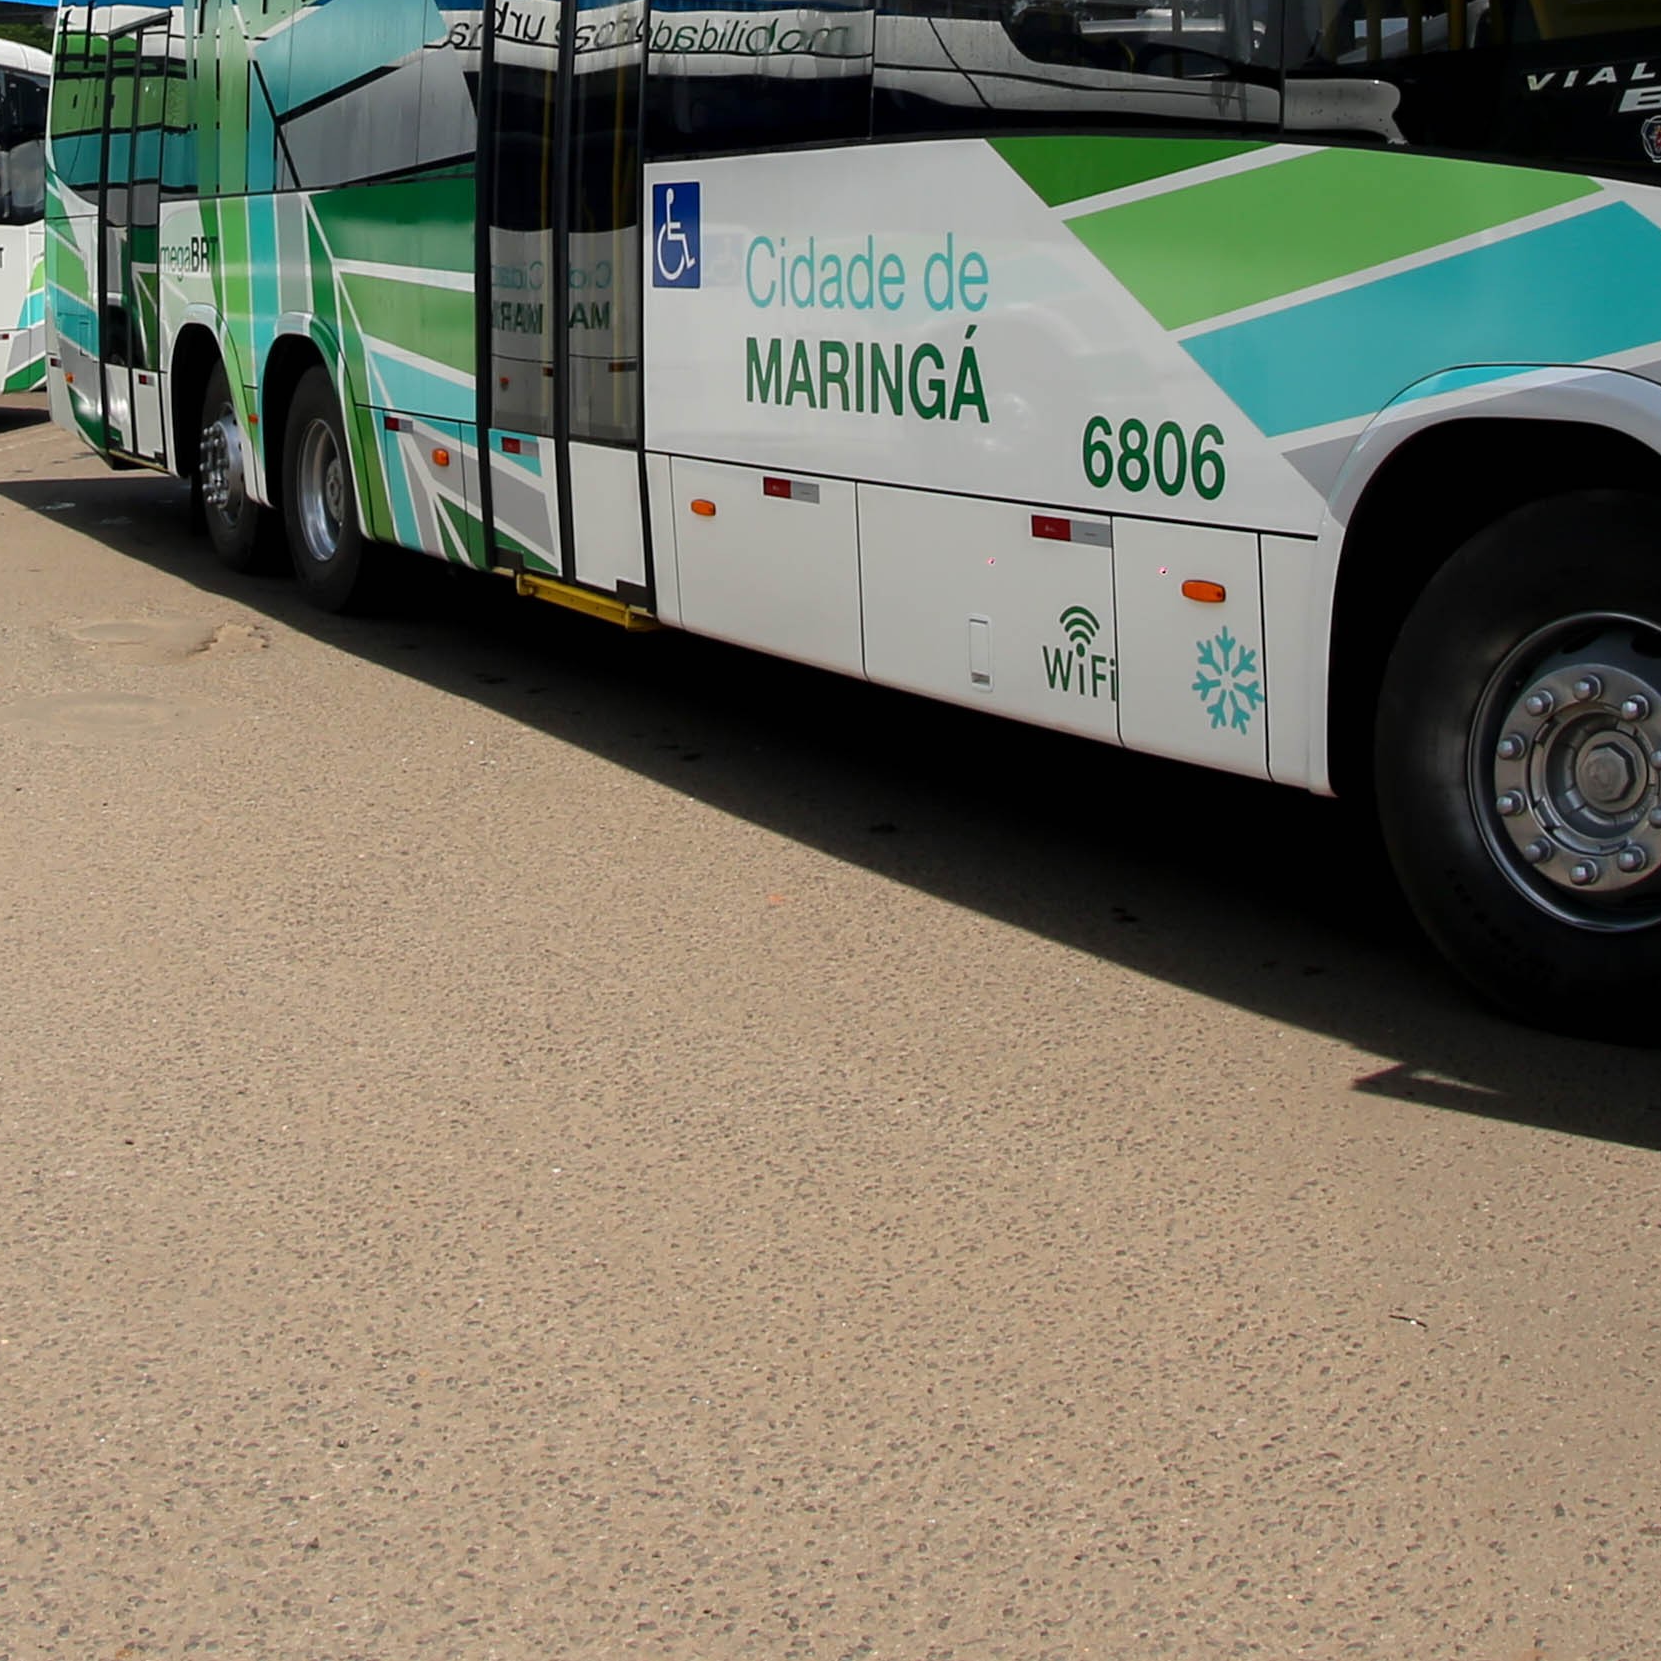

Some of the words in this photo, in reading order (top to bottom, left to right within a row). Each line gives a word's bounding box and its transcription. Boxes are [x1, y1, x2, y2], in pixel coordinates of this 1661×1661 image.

[160, 236, 219, 282] megaBRT
[746, 234, 906, 311] Cidade
[923, 232, 989, 312] de
[746, 324, 990, 424] MARINGÁ
[1083, 415, 1226, 501] 6806
[1042, 643, 1116, 702] WiFi
